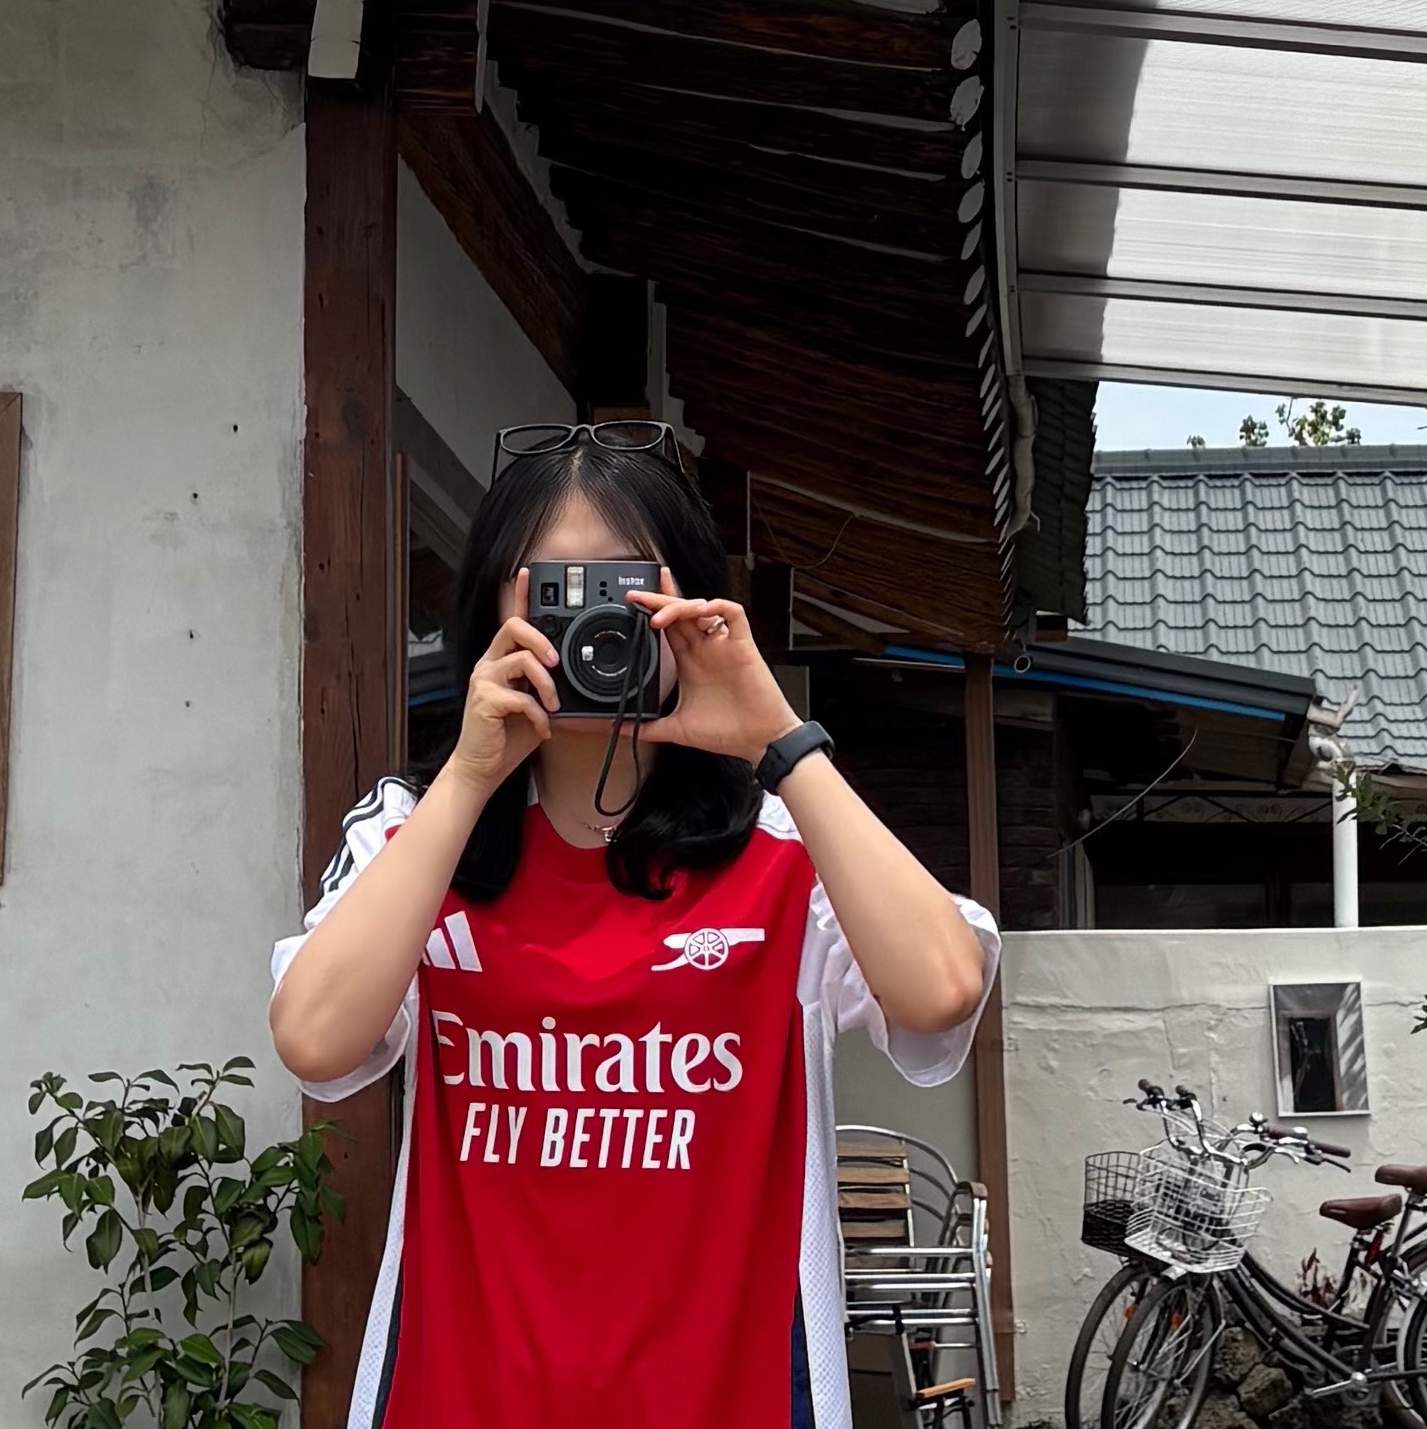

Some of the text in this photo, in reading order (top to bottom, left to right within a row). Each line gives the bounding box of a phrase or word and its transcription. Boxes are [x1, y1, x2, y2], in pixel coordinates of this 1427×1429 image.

[432, 1009, 743, 1093] Emirates
[459, 1102, 695, 1170] FLY BETTER
